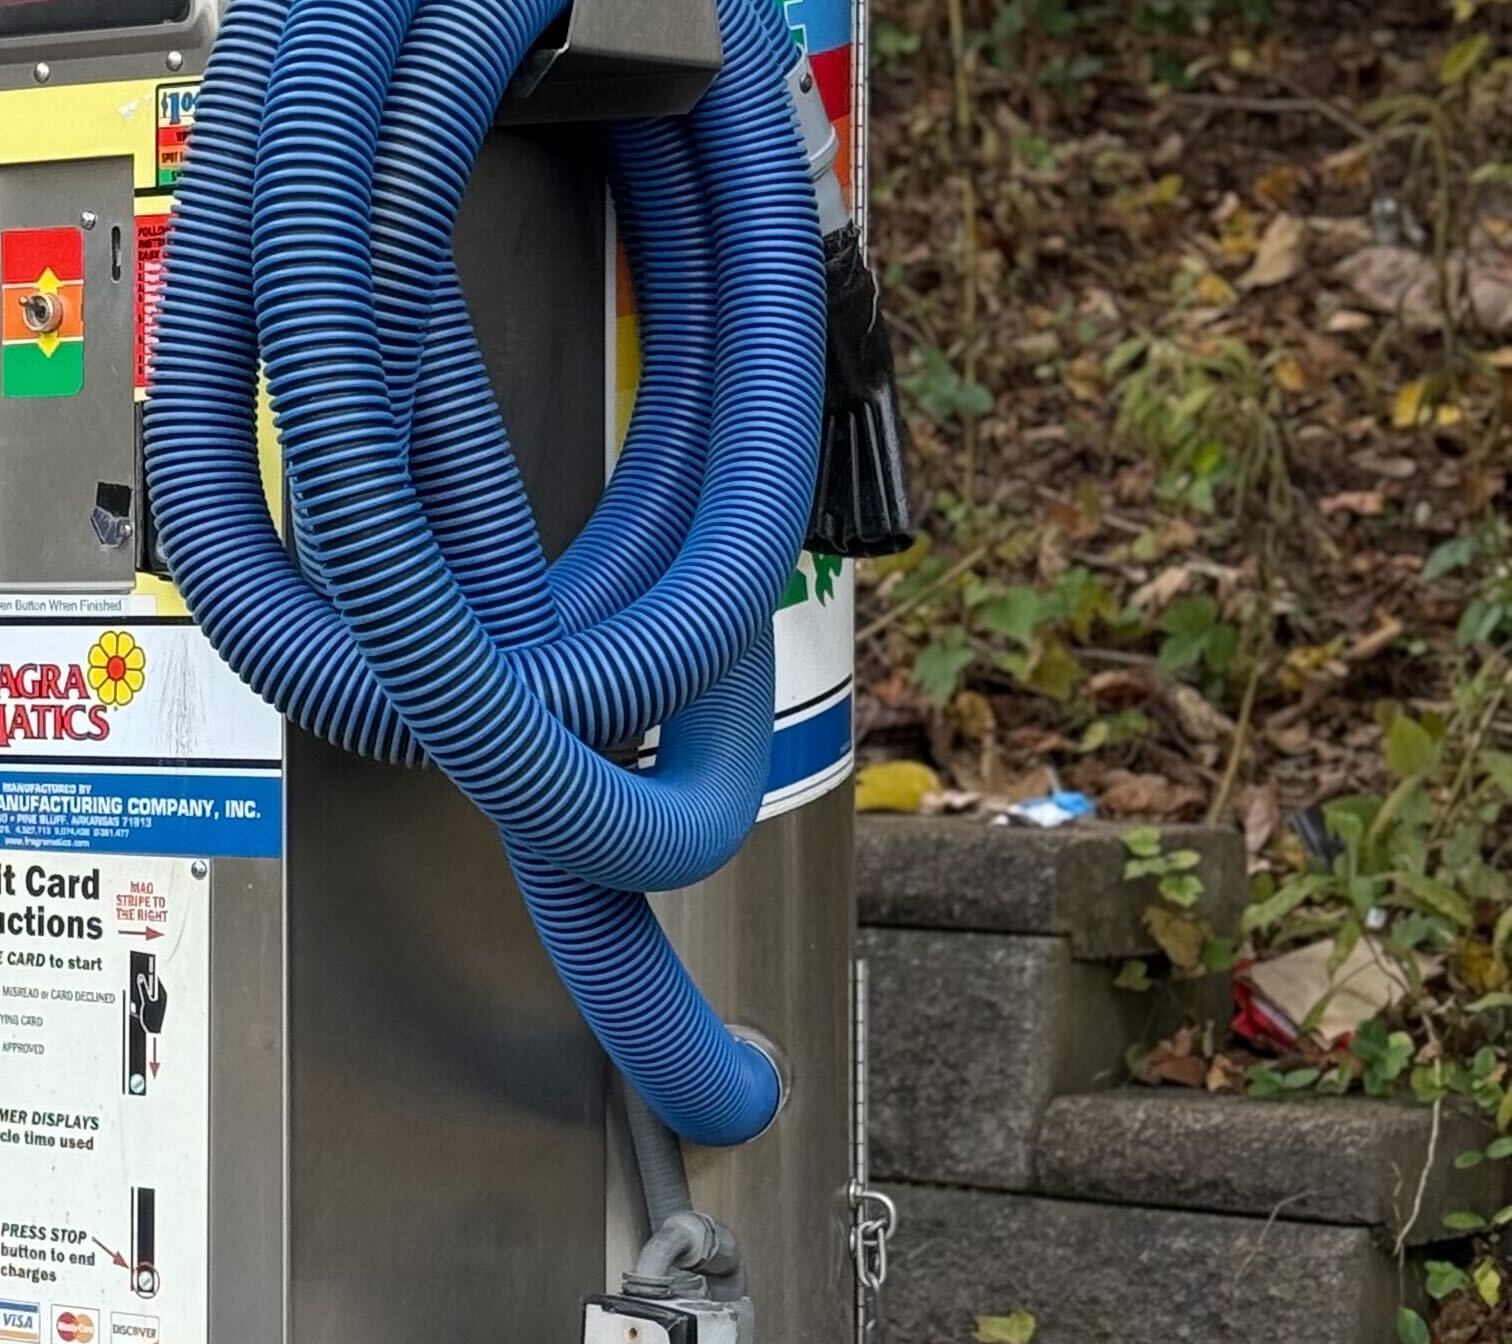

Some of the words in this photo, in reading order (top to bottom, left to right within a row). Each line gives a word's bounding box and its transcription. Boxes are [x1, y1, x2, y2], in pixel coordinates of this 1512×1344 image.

[16, 599, 45, 611] Button
[48, 599, 77, 611] When
[80, 599, 121, 611] Finished
[2, 783, 76, 794] MANUFACTURED
[79, 784, 92, 794] BY
[127, 797, 219, 819] COMPANY,
[225, 799, 261, 819] INC.
[25, 865, 100, 900] Card
[116, 894, 151, 907] STRIPE
[152, 896, 165, 908] TO
[116, 907, 135, 920] THE
[138, 909, 168, 922] RIGHT
[7, 951, 45, 967] CARD
[50, 954, 64, 968] to
[68, 956, 103, 971] start
[2, 986, 39, 998] MISREAD
[51, 989, 73, 1001] CARD
[75, 990, 116, 1004] DECLINED
[21, 1015, 43, 1027] CARD
[2, 1041, 45, 1055] APPROVED
[31, 1111, 99, 1131] DISPLAYS
[24, 1130, 55, 1147] time
[60, 1136, 94, 1150] used
[0, 1222, 46, 1240] PRESS
[50, 1228, 87, 1244] STOP
[0, 1242, 46, 1261] button
[51, 1248, 64, 1262] to
[69, 1252, 95, 1266] end
[0, 1263, 56, 1283] charges
[3, 1312, 33, 1329] VISA
[112, 1324, 157, 1339] DISCOVER
